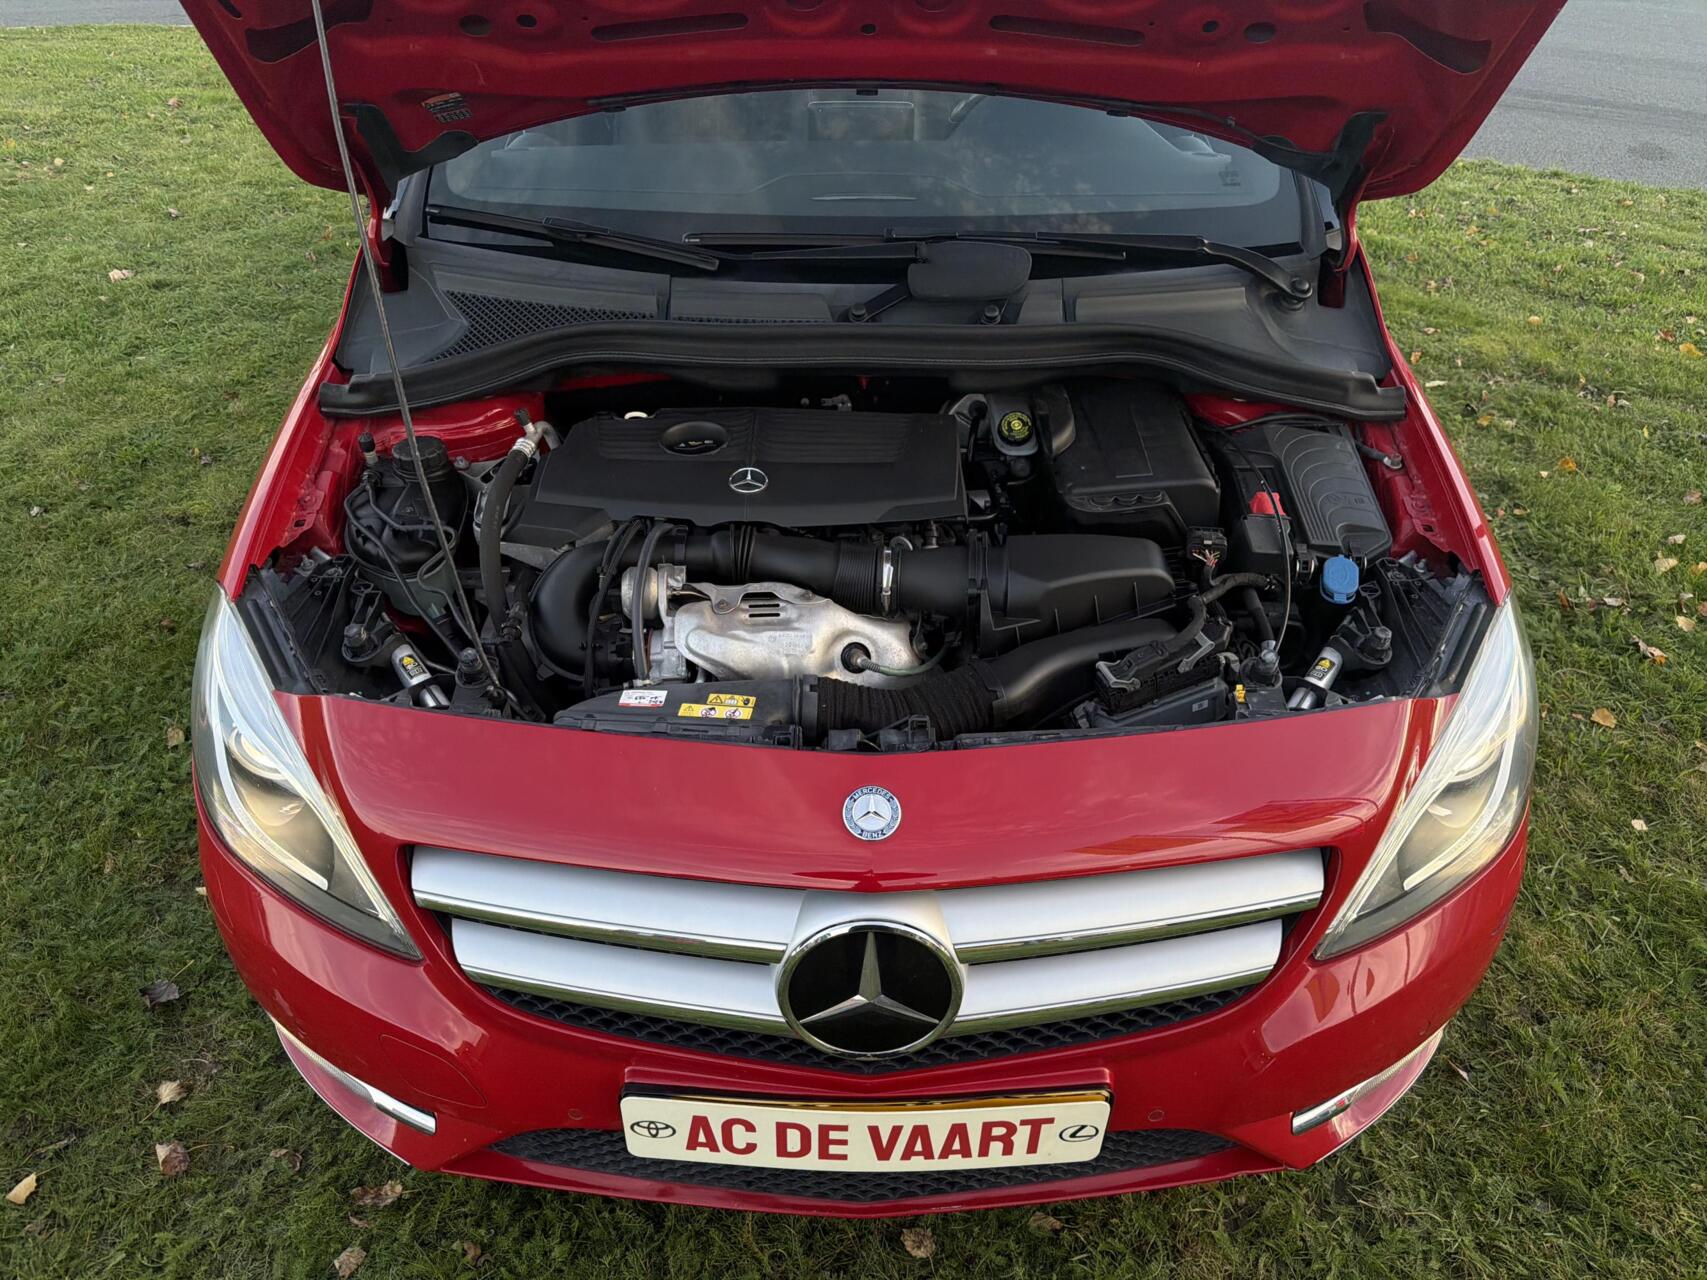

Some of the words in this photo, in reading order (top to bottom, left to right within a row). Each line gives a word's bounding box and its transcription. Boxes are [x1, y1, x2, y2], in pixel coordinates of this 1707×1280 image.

[852, 787, 890, 799] MERCEDES
[862, 831, 882, 839] BENZ
[686, 1115, 757, 1156] AC
[775, 1121, 848, 1160] DE
[867, 1117, 1055, 1161] VAART
